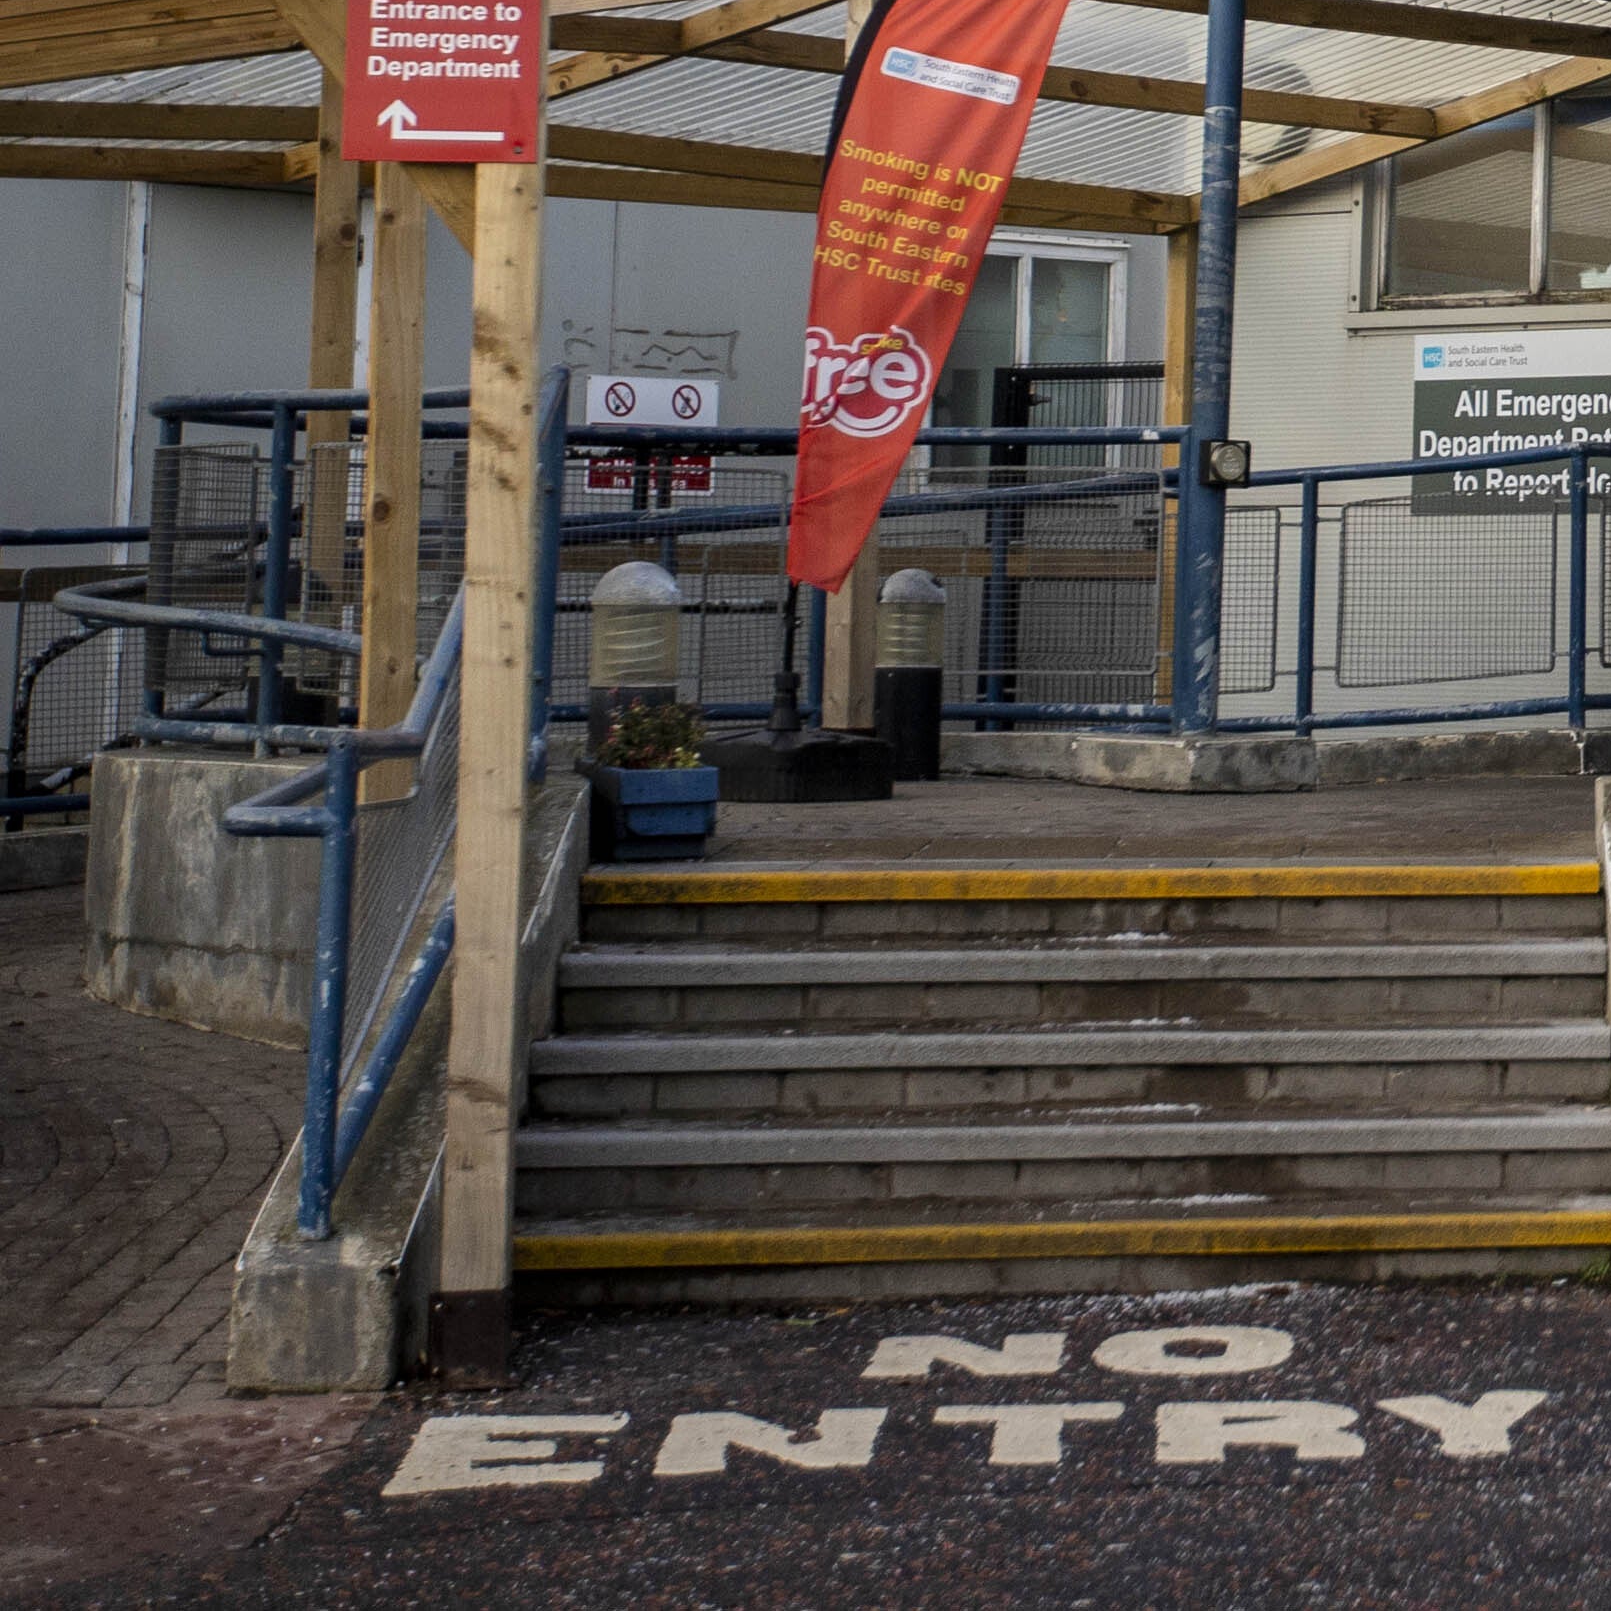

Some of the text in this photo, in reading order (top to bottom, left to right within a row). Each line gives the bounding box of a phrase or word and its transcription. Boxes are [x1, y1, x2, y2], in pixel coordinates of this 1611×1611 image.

[494, 2, 522, 22] to
[370, 27, 520, 55] Emergency
[367, 55, 521, 81] Department
[839, 138, 1005, 194] Smoking is NOT
[860, 176, 966, 213] permitted
[838, 198, 941, 235] anywhere
[826, 220, 888, 251] South
[813, 244, 862, 271] HSC
[866, 256, 922, 286] Trust
[1424, 343, 1525, 363] HSC South Eastern Health
[1448, 355, 1528, 367] and Social Care Trust
[1454, 389, 1489, 418] All
[1419, 428, 1565, 458] Department
[1453, 470, 1478, 496] to
[1486, 468, 1571, 502] Report
[858, 1323, 1294, 1380] NO
[381, 1390, 1548, 1498] ENTRY
